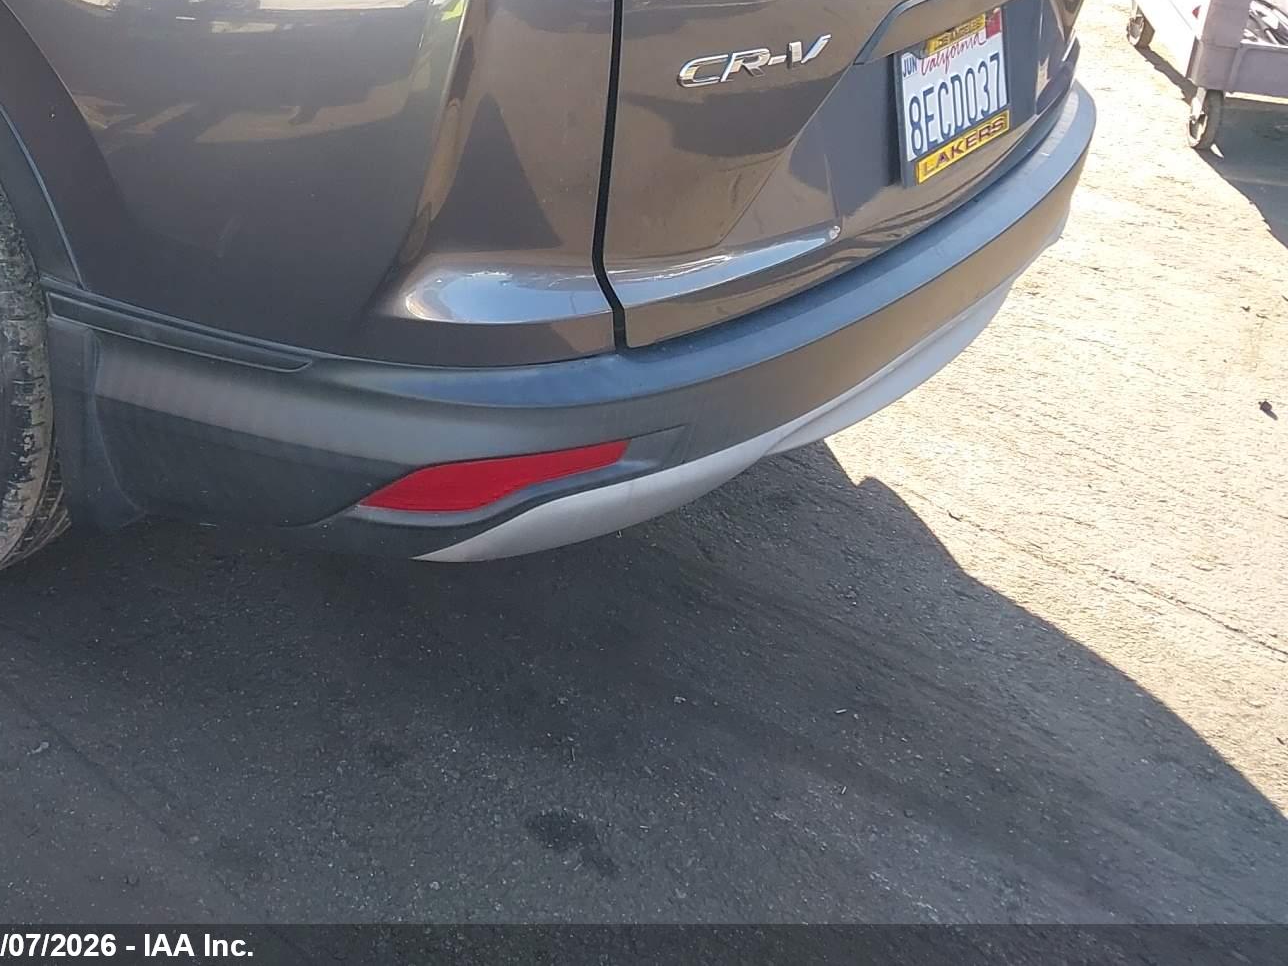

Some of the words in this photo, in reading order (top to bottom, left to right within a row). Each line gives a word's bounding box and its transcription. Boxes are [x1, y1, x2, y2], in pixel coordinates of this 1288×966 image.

[677, 34, 831, 87] CR-V
[903, 56, 918, 78] JUN
[921, 32, 987, 76] California
[909, 52, 1000, 157] 8ECD037
[923, 115, 1005, 174] LAKERS
